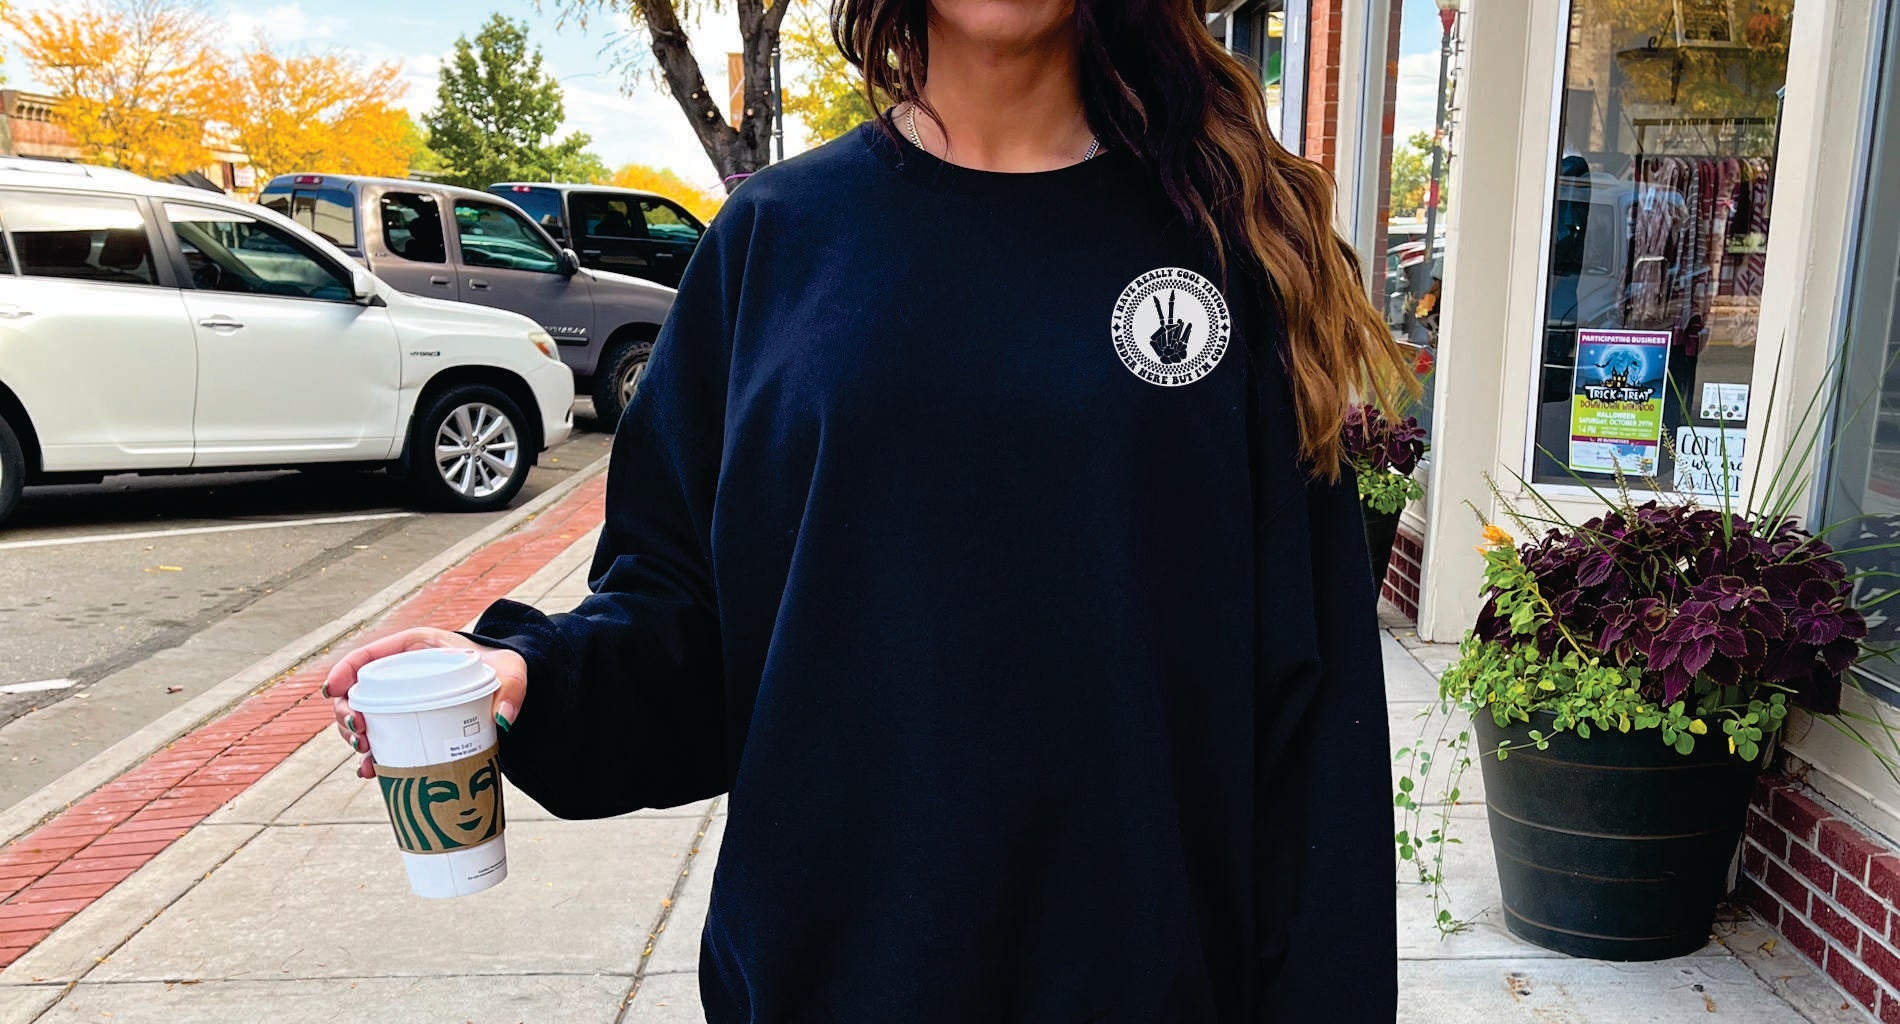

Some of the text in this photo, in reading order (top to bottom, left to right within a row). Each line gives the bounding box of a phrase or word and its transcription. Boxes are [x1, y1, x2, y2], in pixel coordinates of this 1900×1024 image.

[1116, 284, 1136, 313] HAVE
[1135, 269, 1173, 287] REALLY
[1177, 270, 1200, 285] COOL
[1201, 281, 1228, 320] TATTOOS
[1581, 335, 1666, 344] PARTICIPATING BUSINESS
[1114, 335, 1228, 385] UNDER HERE BUT I'M COLD
[1585, 386, 1617, 399] TRICK
[1620, 388, 1654, 400] TREAT
[1580, 400, 1620, 410] DOWNTOWN
[1596, 411, 1636, 419] HALLOWEEN
[1681, 434, 1733, 457] COME
